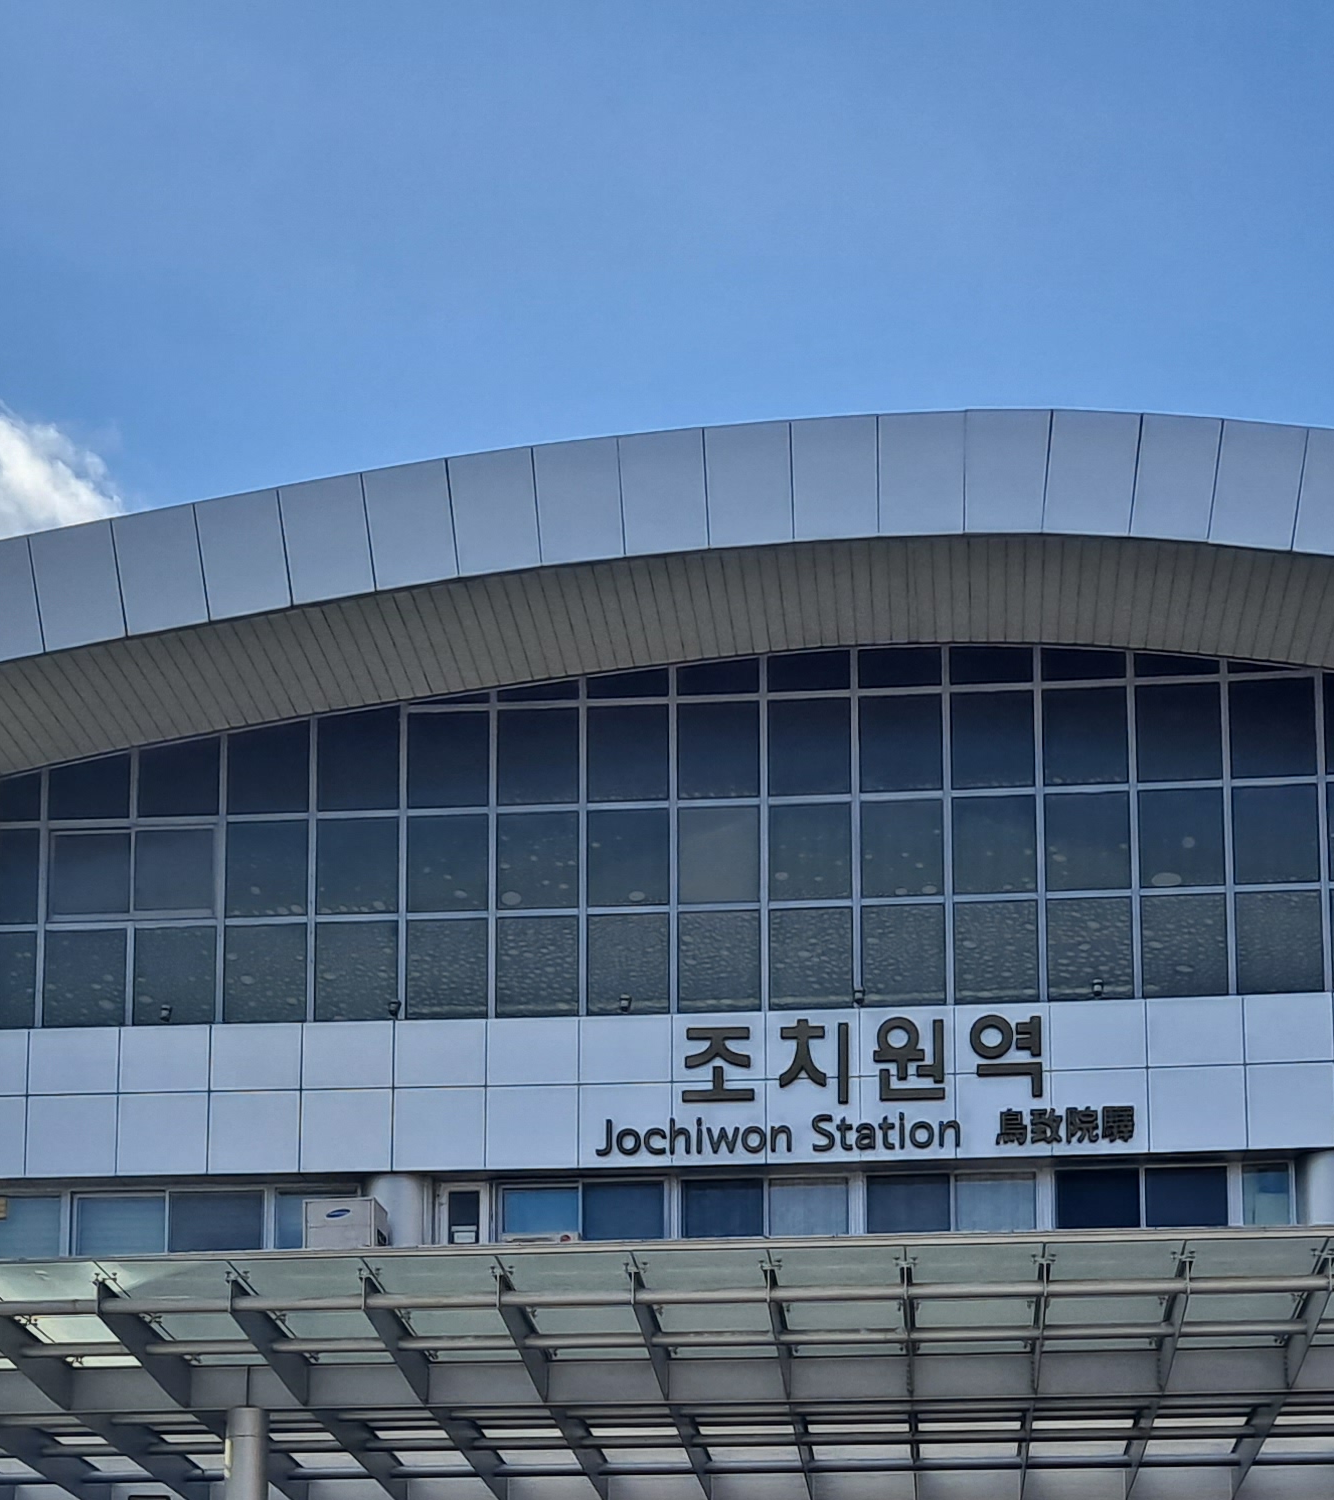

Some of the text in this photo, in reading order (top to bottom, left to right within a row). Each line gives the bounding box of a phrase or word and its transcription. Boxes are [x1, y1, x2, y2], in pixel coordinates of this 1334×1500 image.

[681, 1013, 1043, 1104] 조치원역
[595, 1112, 961, 1157] Jochiwon Station
[995, 1105, 1136, 1146] 鳥致院驛
